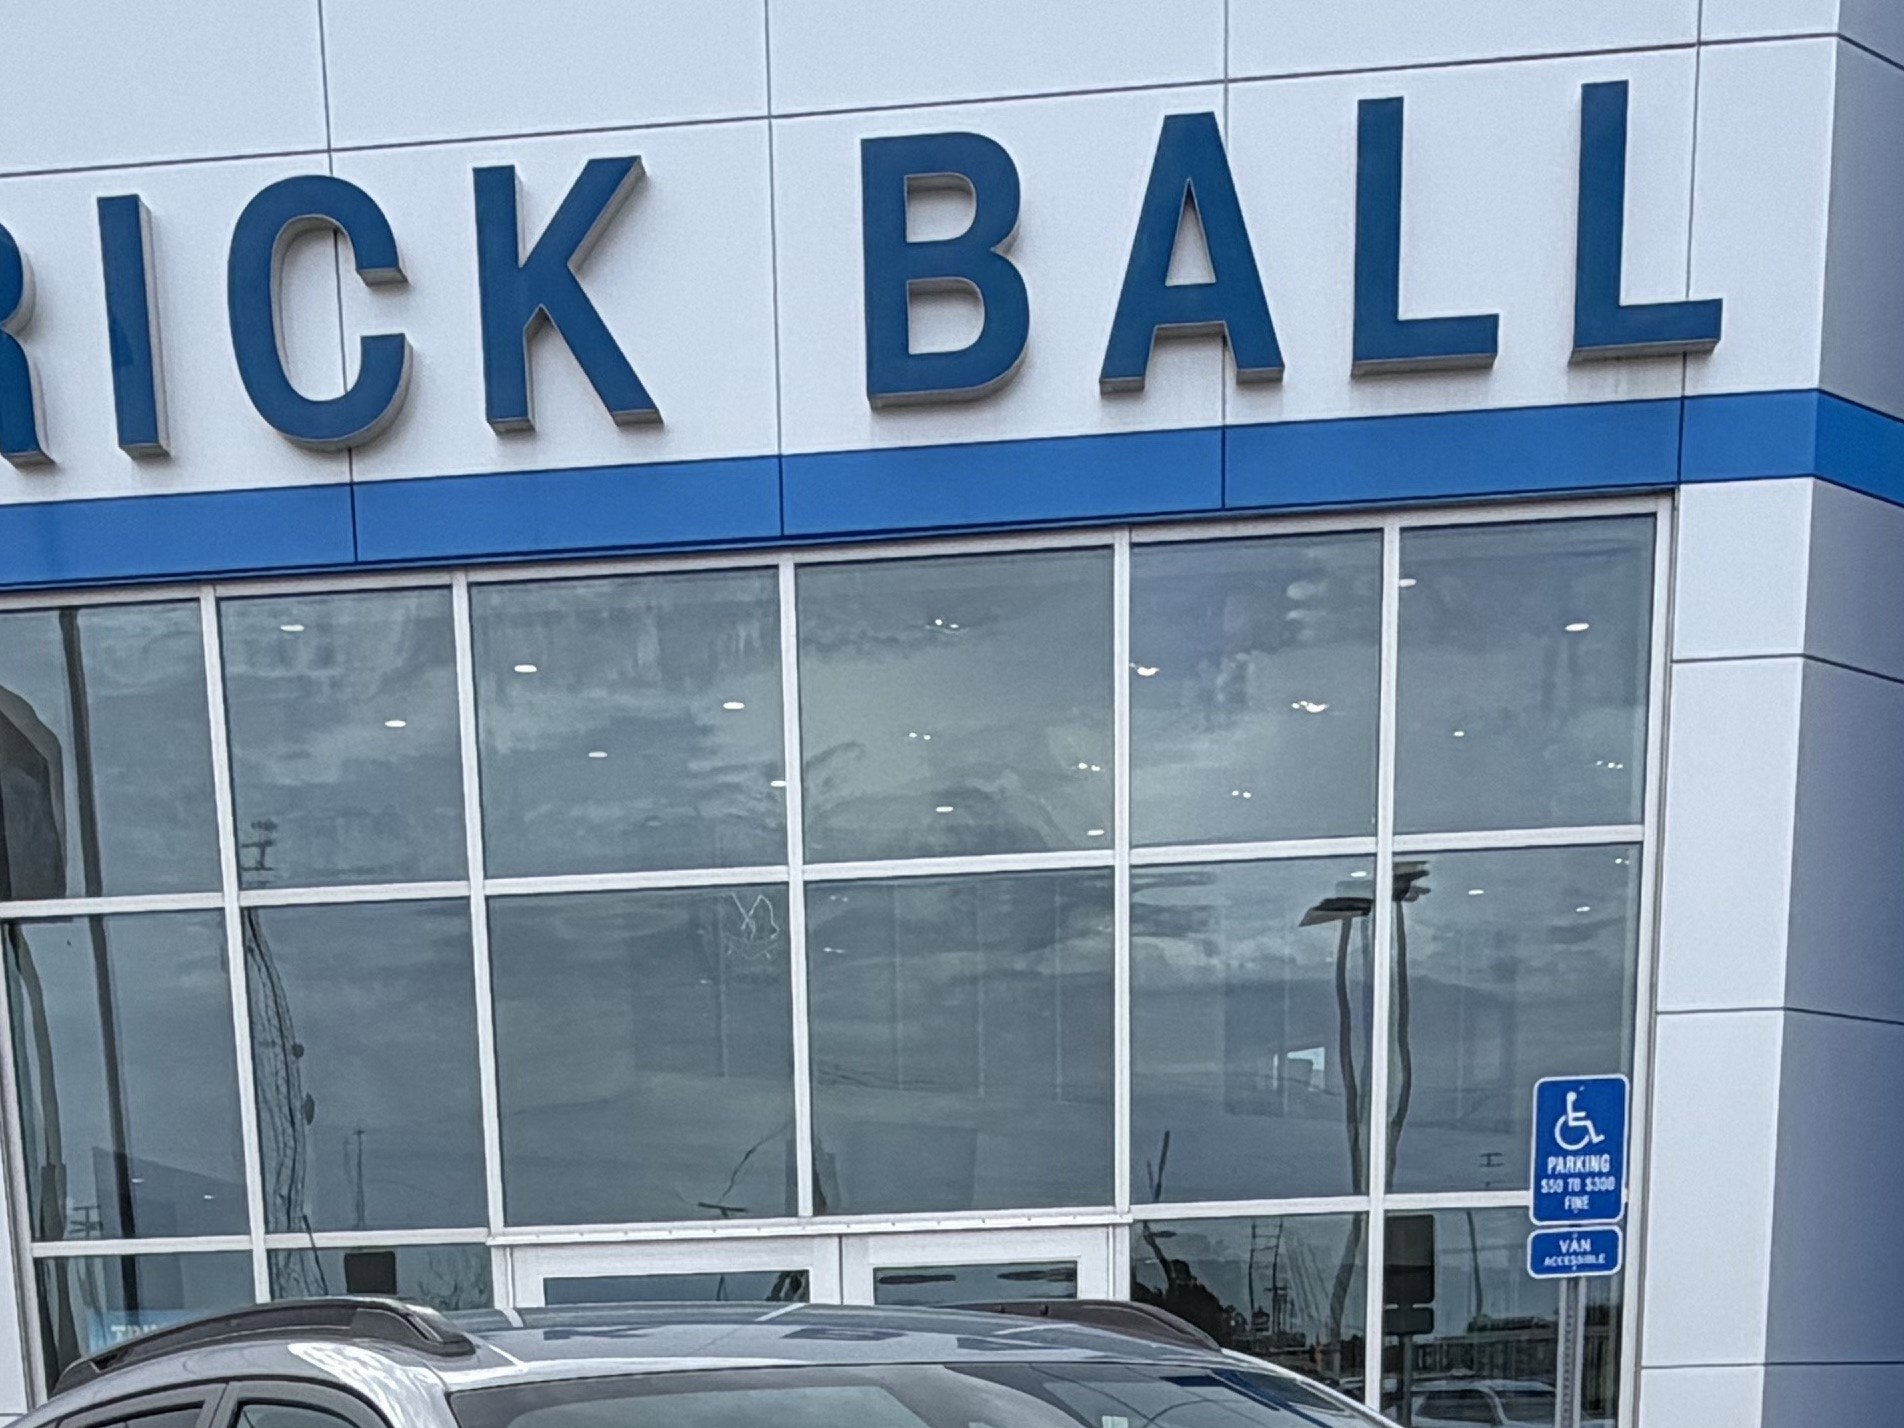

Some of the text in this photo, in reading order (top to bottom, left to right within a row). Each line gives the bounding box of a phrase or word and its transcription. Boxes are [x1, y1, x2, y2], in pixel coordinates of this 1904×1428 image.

[859, 78, 1724, 411] BALL
[1547, 1153, 1611, 1175] PARKING
[1567, 1177, 1582, 1192] TO
[1564, 1194, 1590, 1211] FINE
[1558, 1238, 1592, 1254] VAN
[1543, 1253, 1607, 1267] ACCESSIBLE
